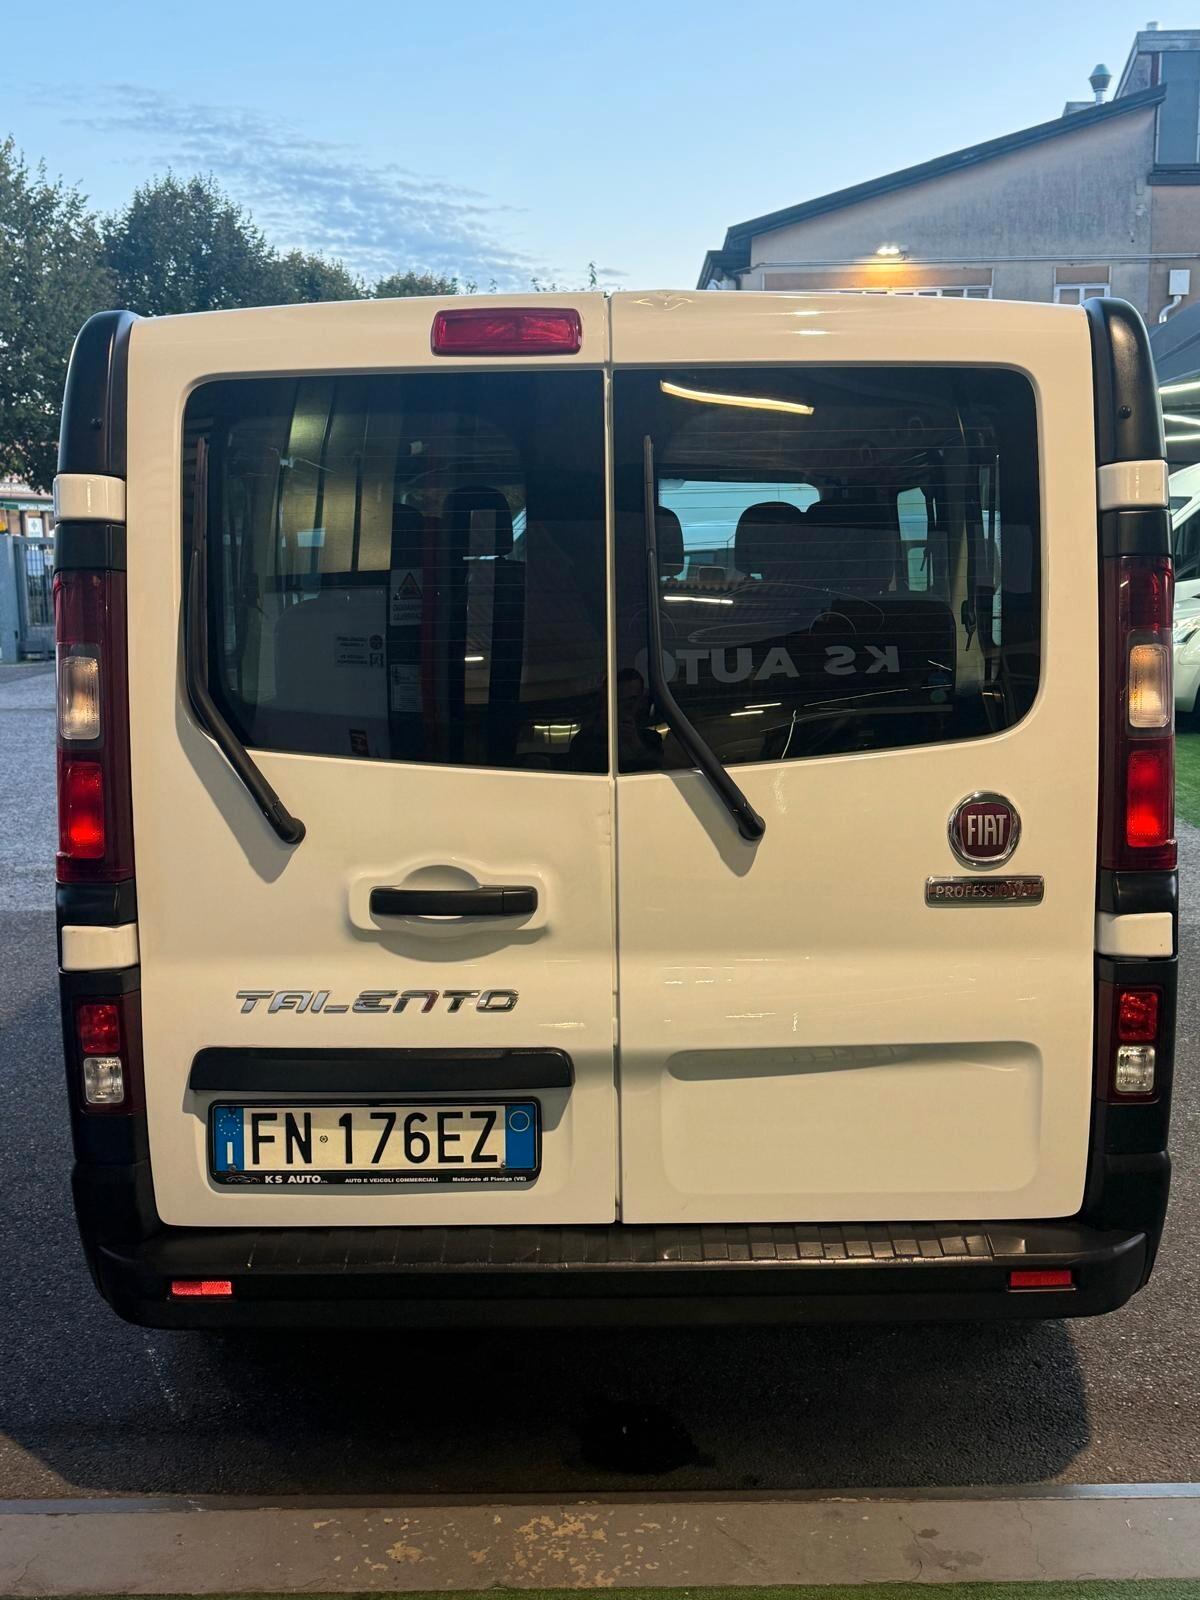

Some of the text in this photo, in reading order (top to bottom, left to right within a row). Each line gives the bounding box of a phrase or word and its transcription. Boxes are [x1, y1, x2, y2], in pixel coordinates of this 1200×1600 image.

[967, 814, 1008, 846] FIAT
[235, 988, 520, 1014] TALENTO
[287, 1175, 322, 1184] AUTO
